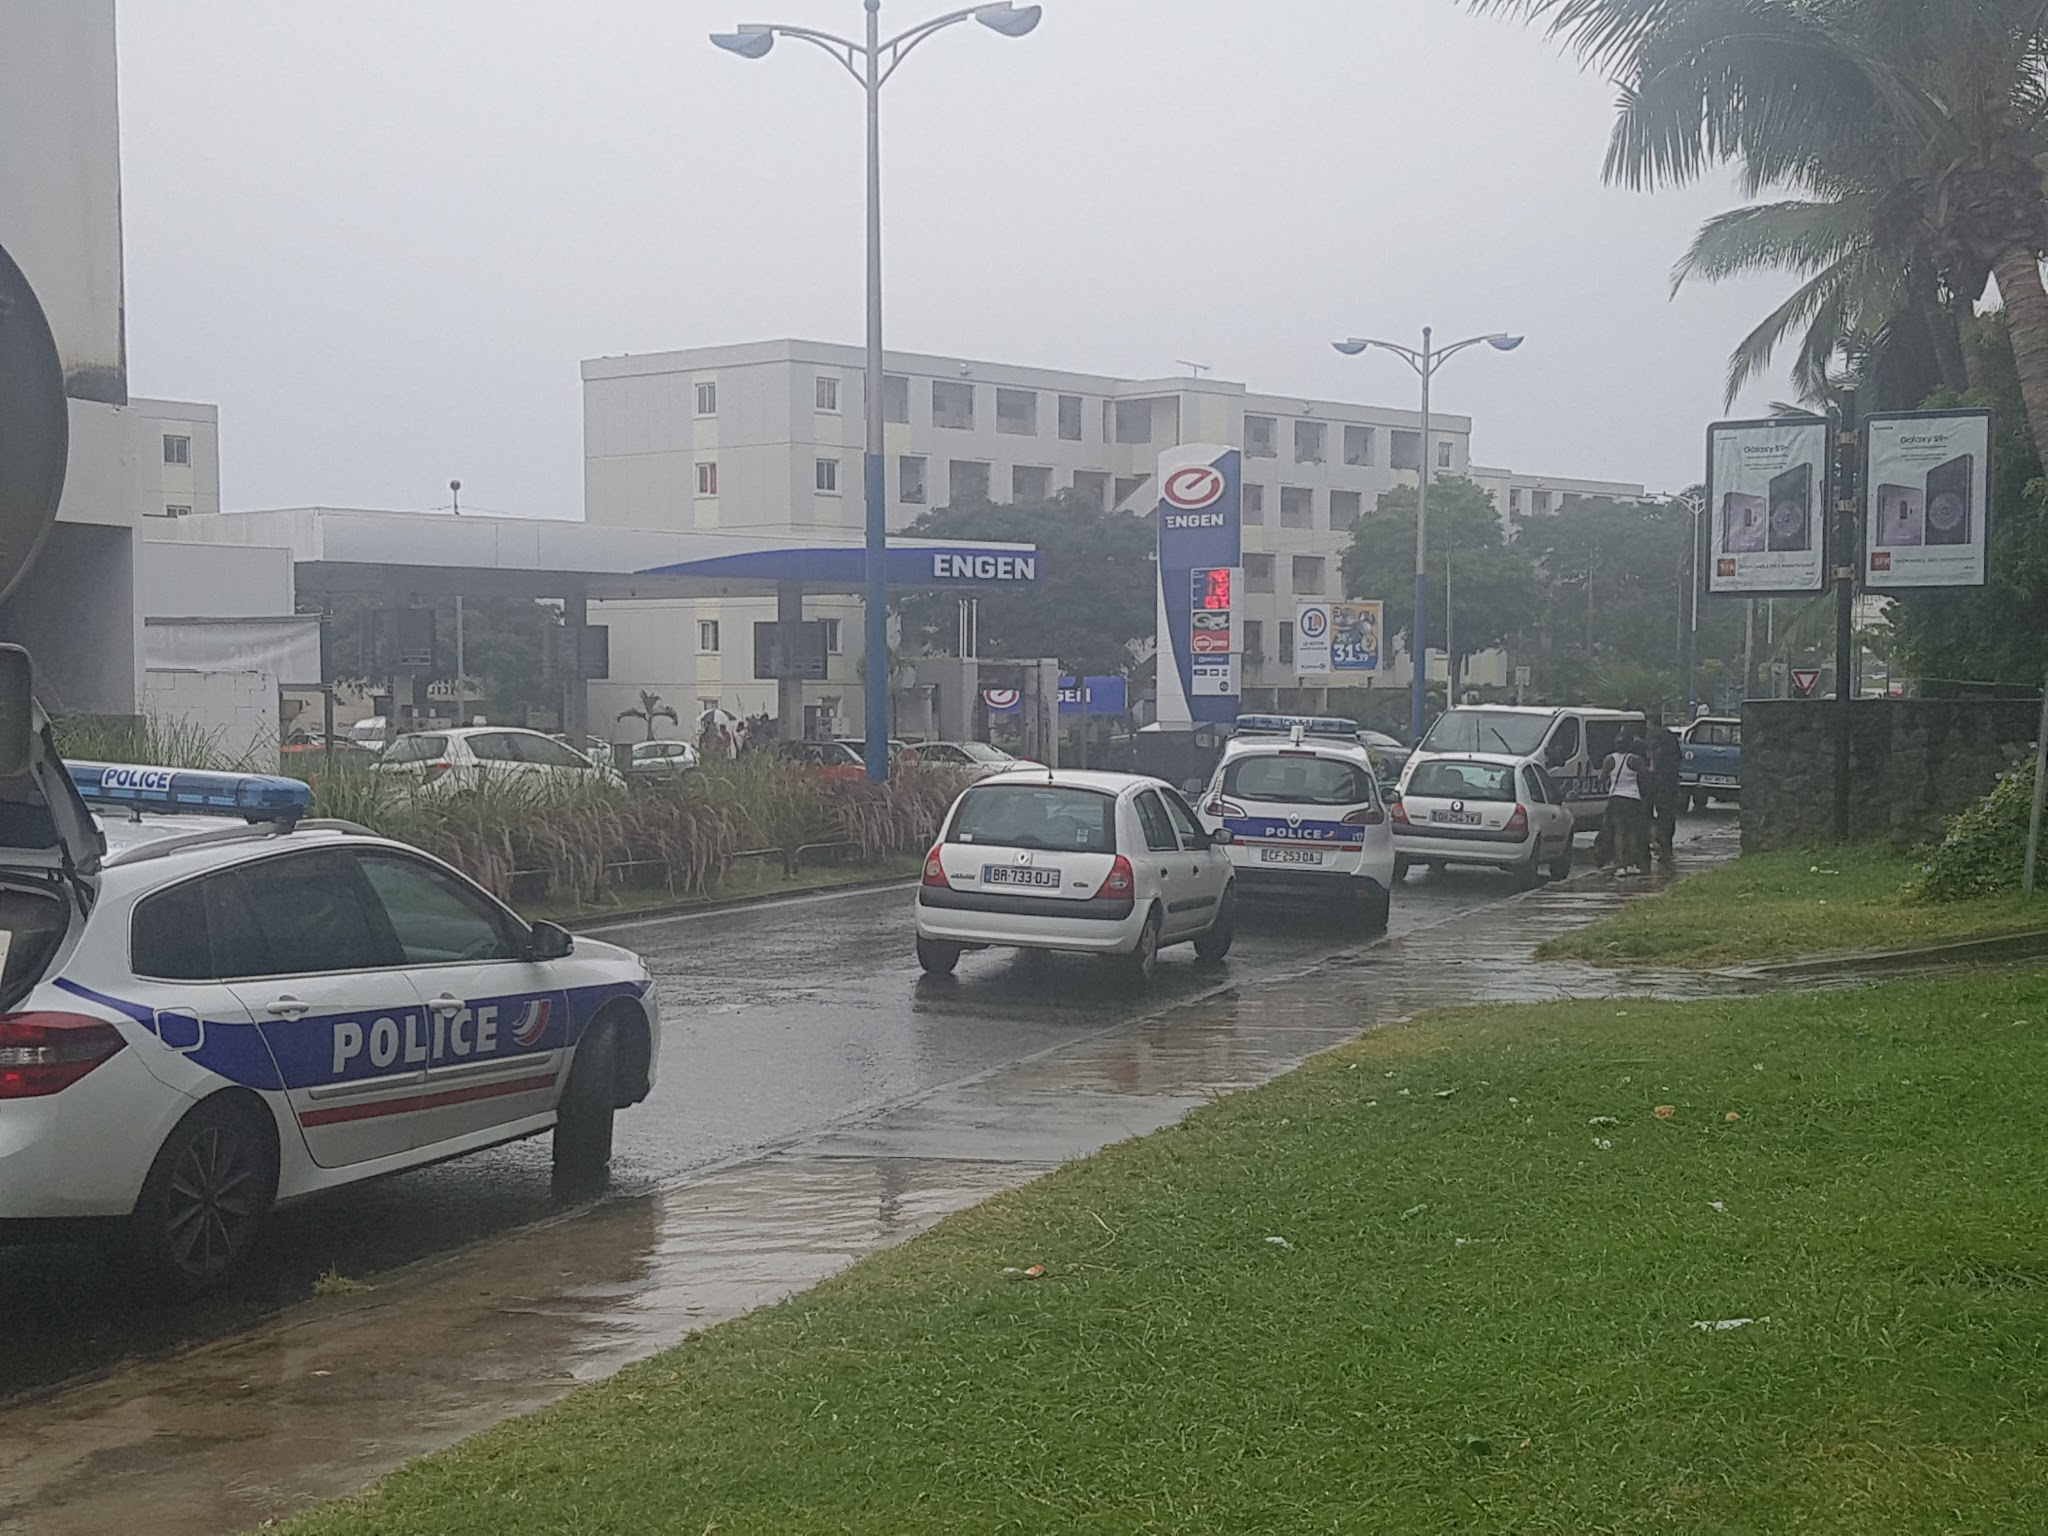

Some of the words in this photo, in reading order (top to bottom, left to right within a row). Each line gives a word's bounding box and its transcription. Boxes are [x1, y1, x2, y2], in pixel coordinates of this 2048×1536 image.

[1165, 513, 1224, 529] ENGEN
[933, 553, 1036, 580] ENGEN
[104, 769, 170, 789] POLICE
[1265, 826, 1322, 840] POLICE
[331, 1005, 499, 1074] POLICE
